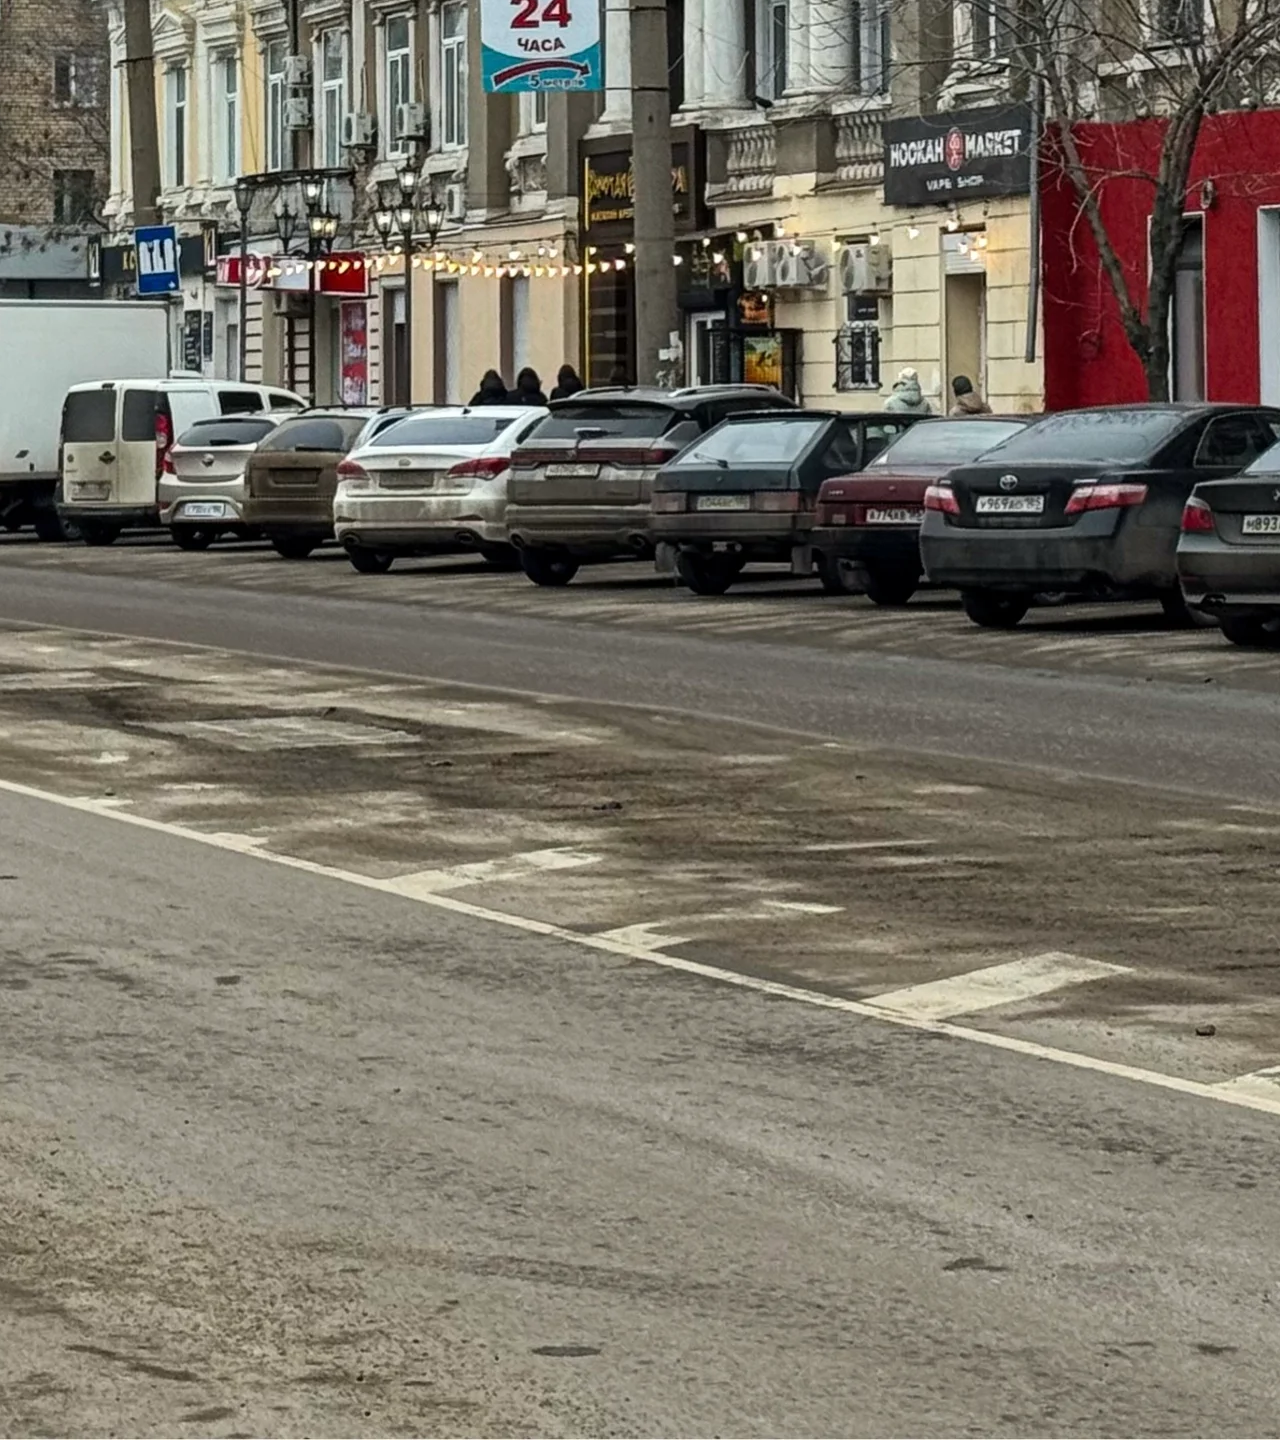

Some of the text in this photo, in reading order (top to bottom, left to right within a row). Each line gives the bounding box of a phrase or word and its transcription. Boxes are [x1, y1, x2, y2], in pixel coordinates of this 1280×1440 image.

[517, 37, 566, 52] ЧАСА
[890, 129, 1022, 168] HOOKAH MARKET
[926, 175, 984, 192] VAPE SHOP
